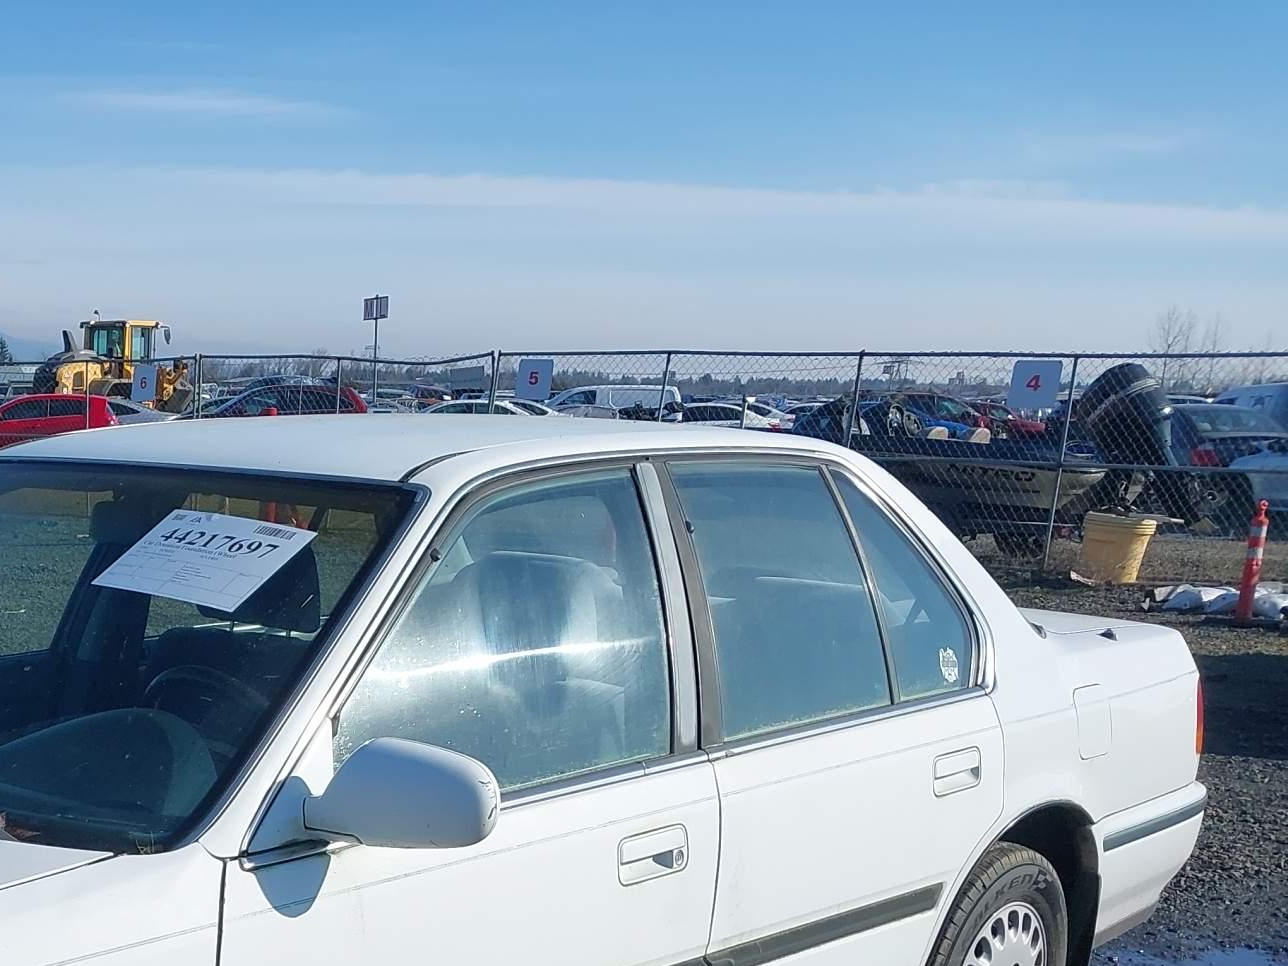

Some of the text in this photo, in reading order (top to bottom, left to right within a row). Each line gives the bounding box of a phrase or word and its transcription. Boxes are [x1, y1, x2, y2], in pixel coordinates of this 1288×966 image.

[140, 376, 147, 389] 6
[528, 371, 539, 385] 5
[1026, 375, 1041, 391] 4
[161, 527, 280, 559] 44217697
